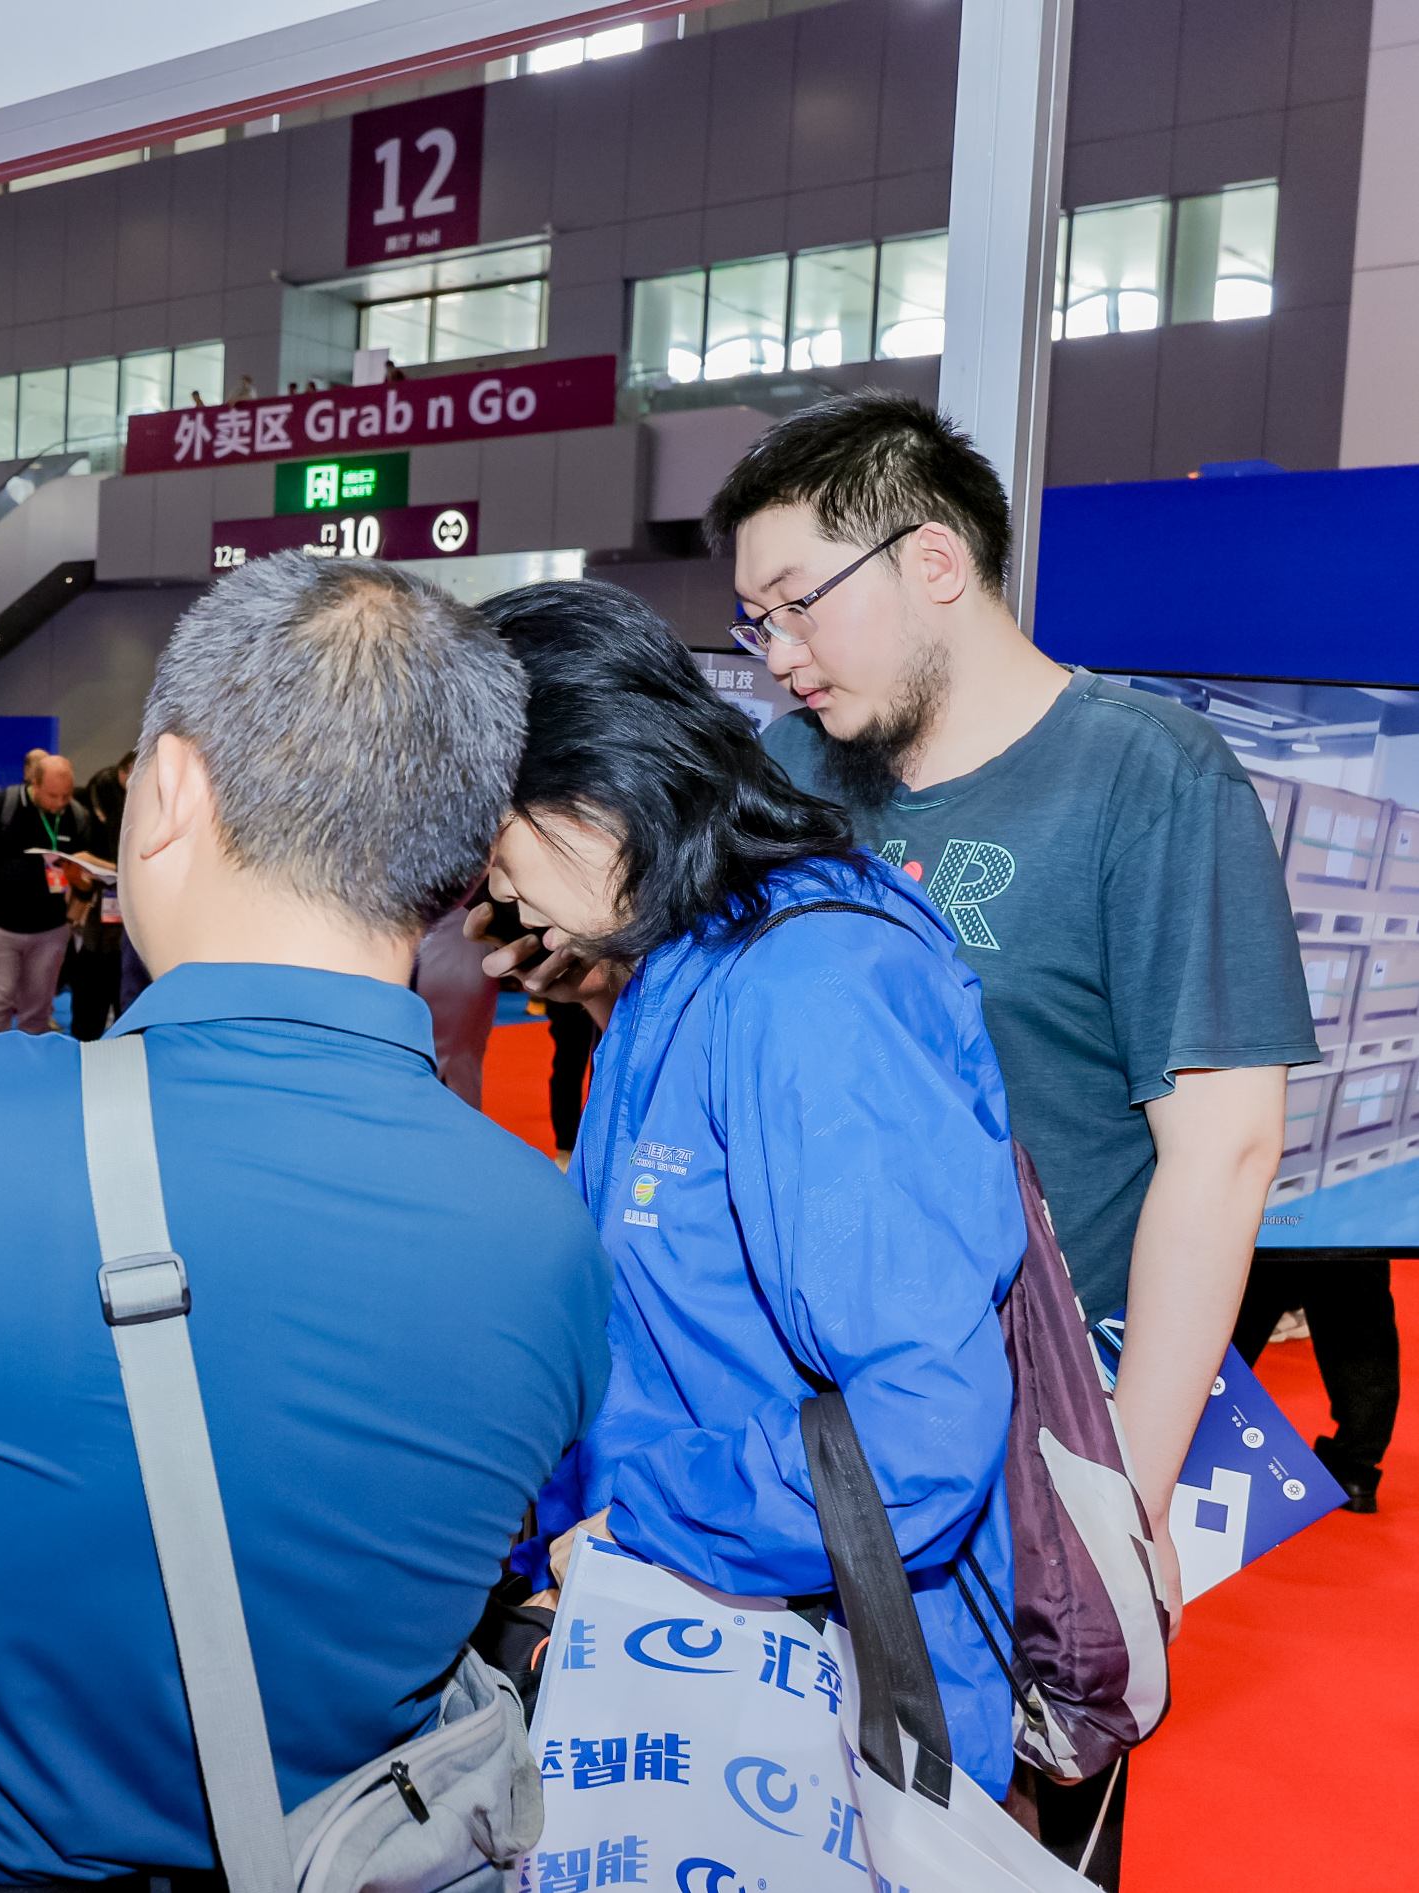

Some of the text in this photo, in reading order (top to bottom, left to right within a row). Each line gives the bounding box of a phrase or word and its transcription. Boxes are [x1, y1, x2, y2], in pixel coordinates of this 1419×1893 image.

[373, 127, 457, 226] 12
[174, 378, 537, 462] 外卖区 Grab n Go
[339, 515, 380, 558] 10
